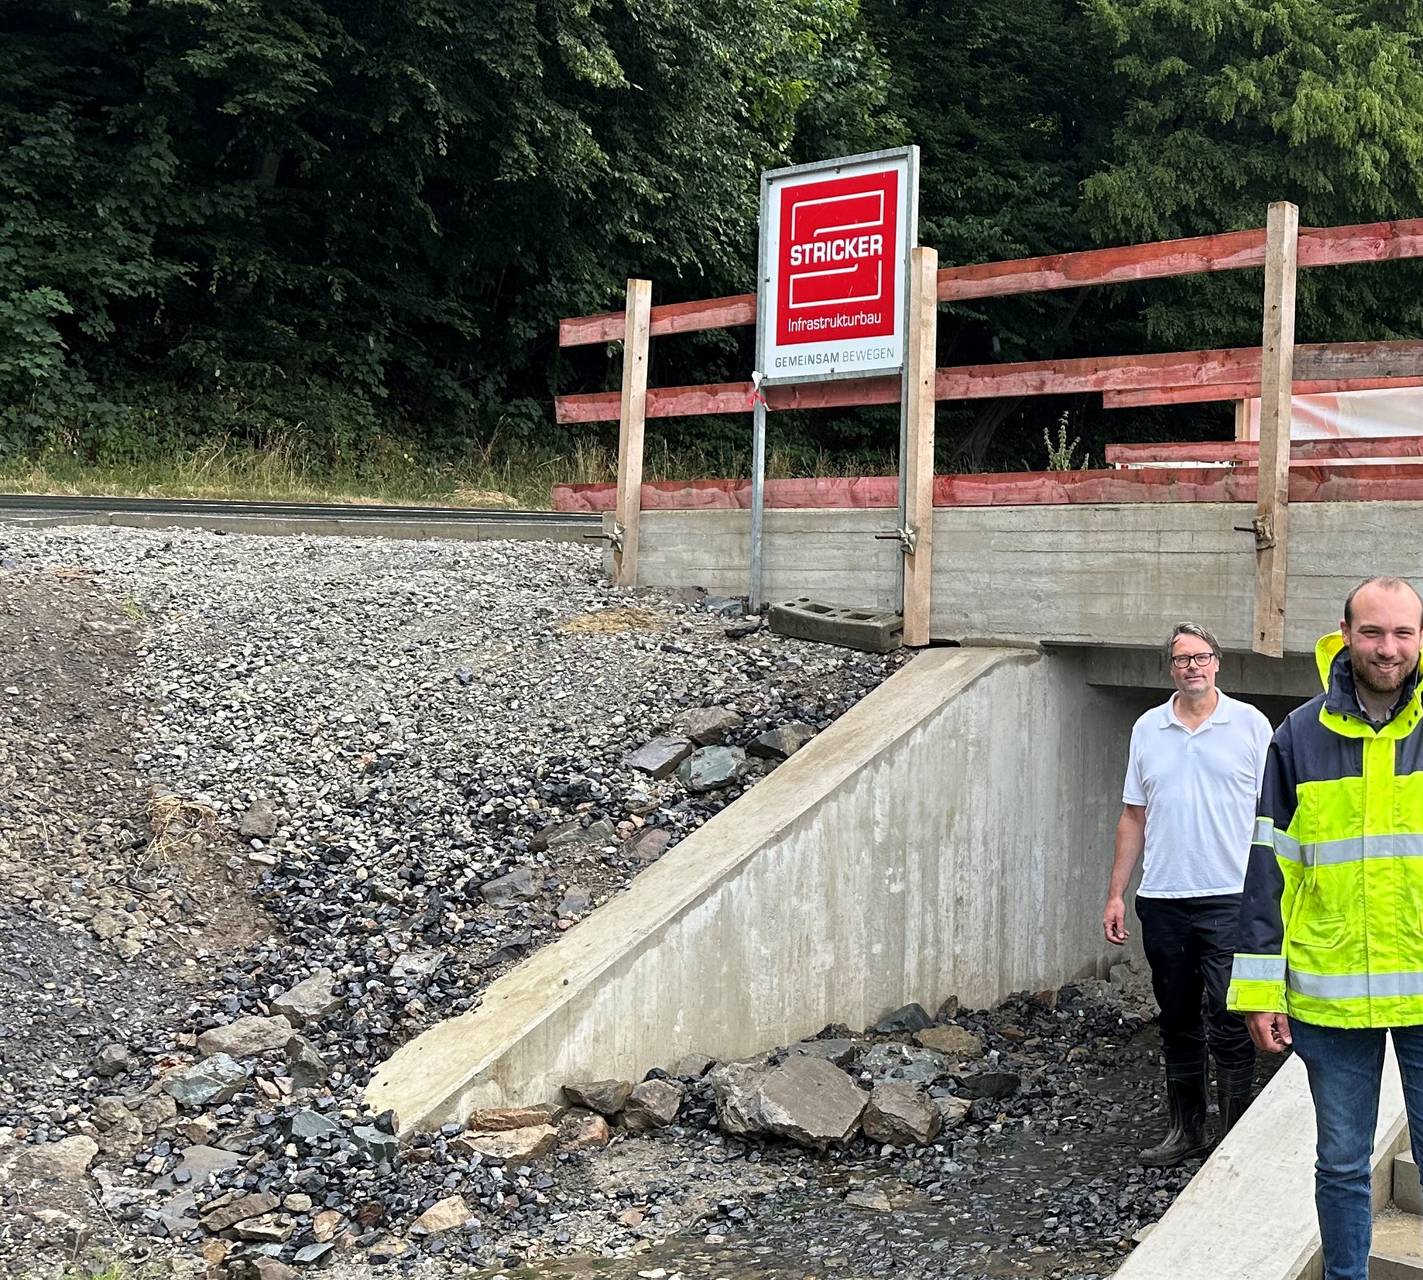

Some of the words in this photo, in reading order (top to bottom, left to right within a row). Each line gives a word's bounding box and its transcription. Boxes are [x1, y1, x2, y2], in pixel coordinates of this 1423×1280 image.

[790, 234, 883, 266] STRICKER
[788, 311, 882, 332] Infrastrukturbau
[775, 352, 840, 368] GEMEINSAM
[842, 347, 895, 363] BEWEGEN
